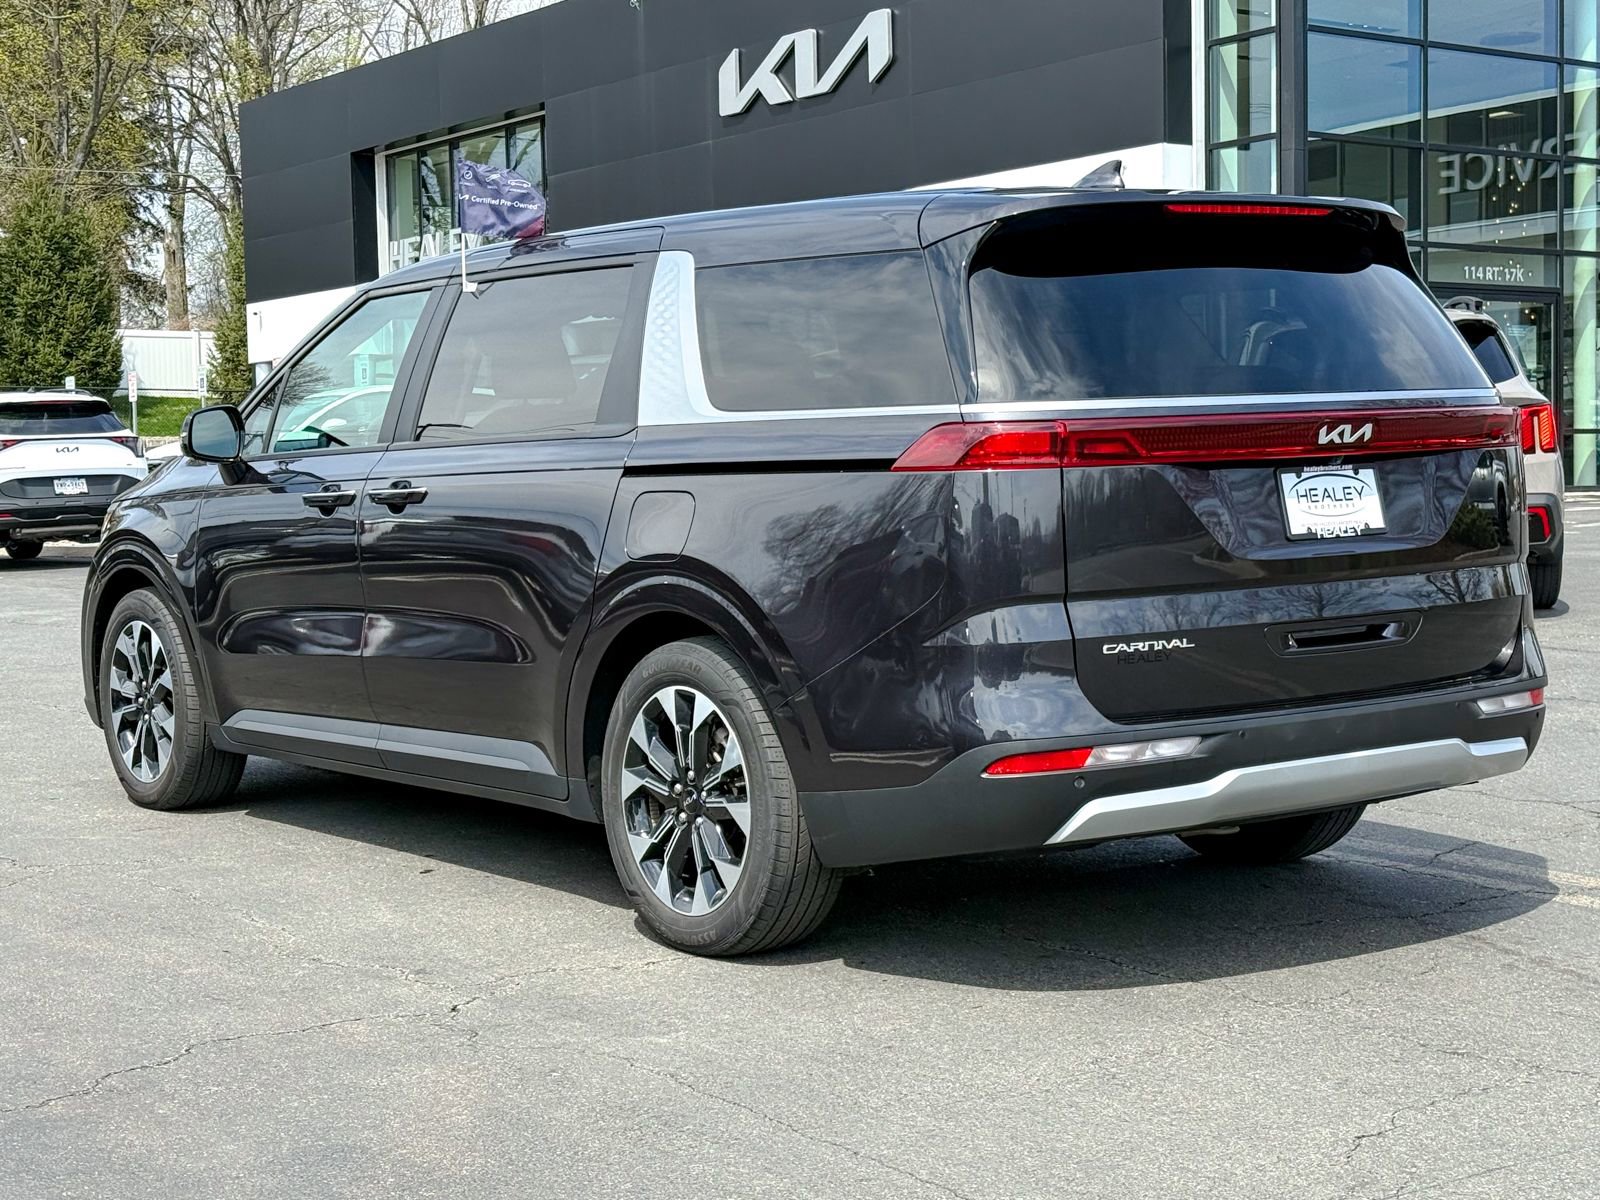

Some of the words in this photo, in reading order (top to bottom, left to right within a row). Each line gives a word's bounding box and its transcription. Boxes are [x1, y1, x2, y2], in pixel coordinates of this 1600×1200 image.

[718, 8, 893, 117] KIA
[471, 196, 499, 206] Certified
[500, 199, 538, 210] Pre-Owned
[1463, 266, 1484, 280] 114
[1504, 268, 1524, 282] 17K
[1318, 423, 1373, 445] KIA
[1295, 485, 1364, 504] HEALEY
[1316, 525, 1361, 539] HEALEY
[1102, 638, 1196, 655] CARNIVAL
[1116, 650, 1172, 665] HEALEY
